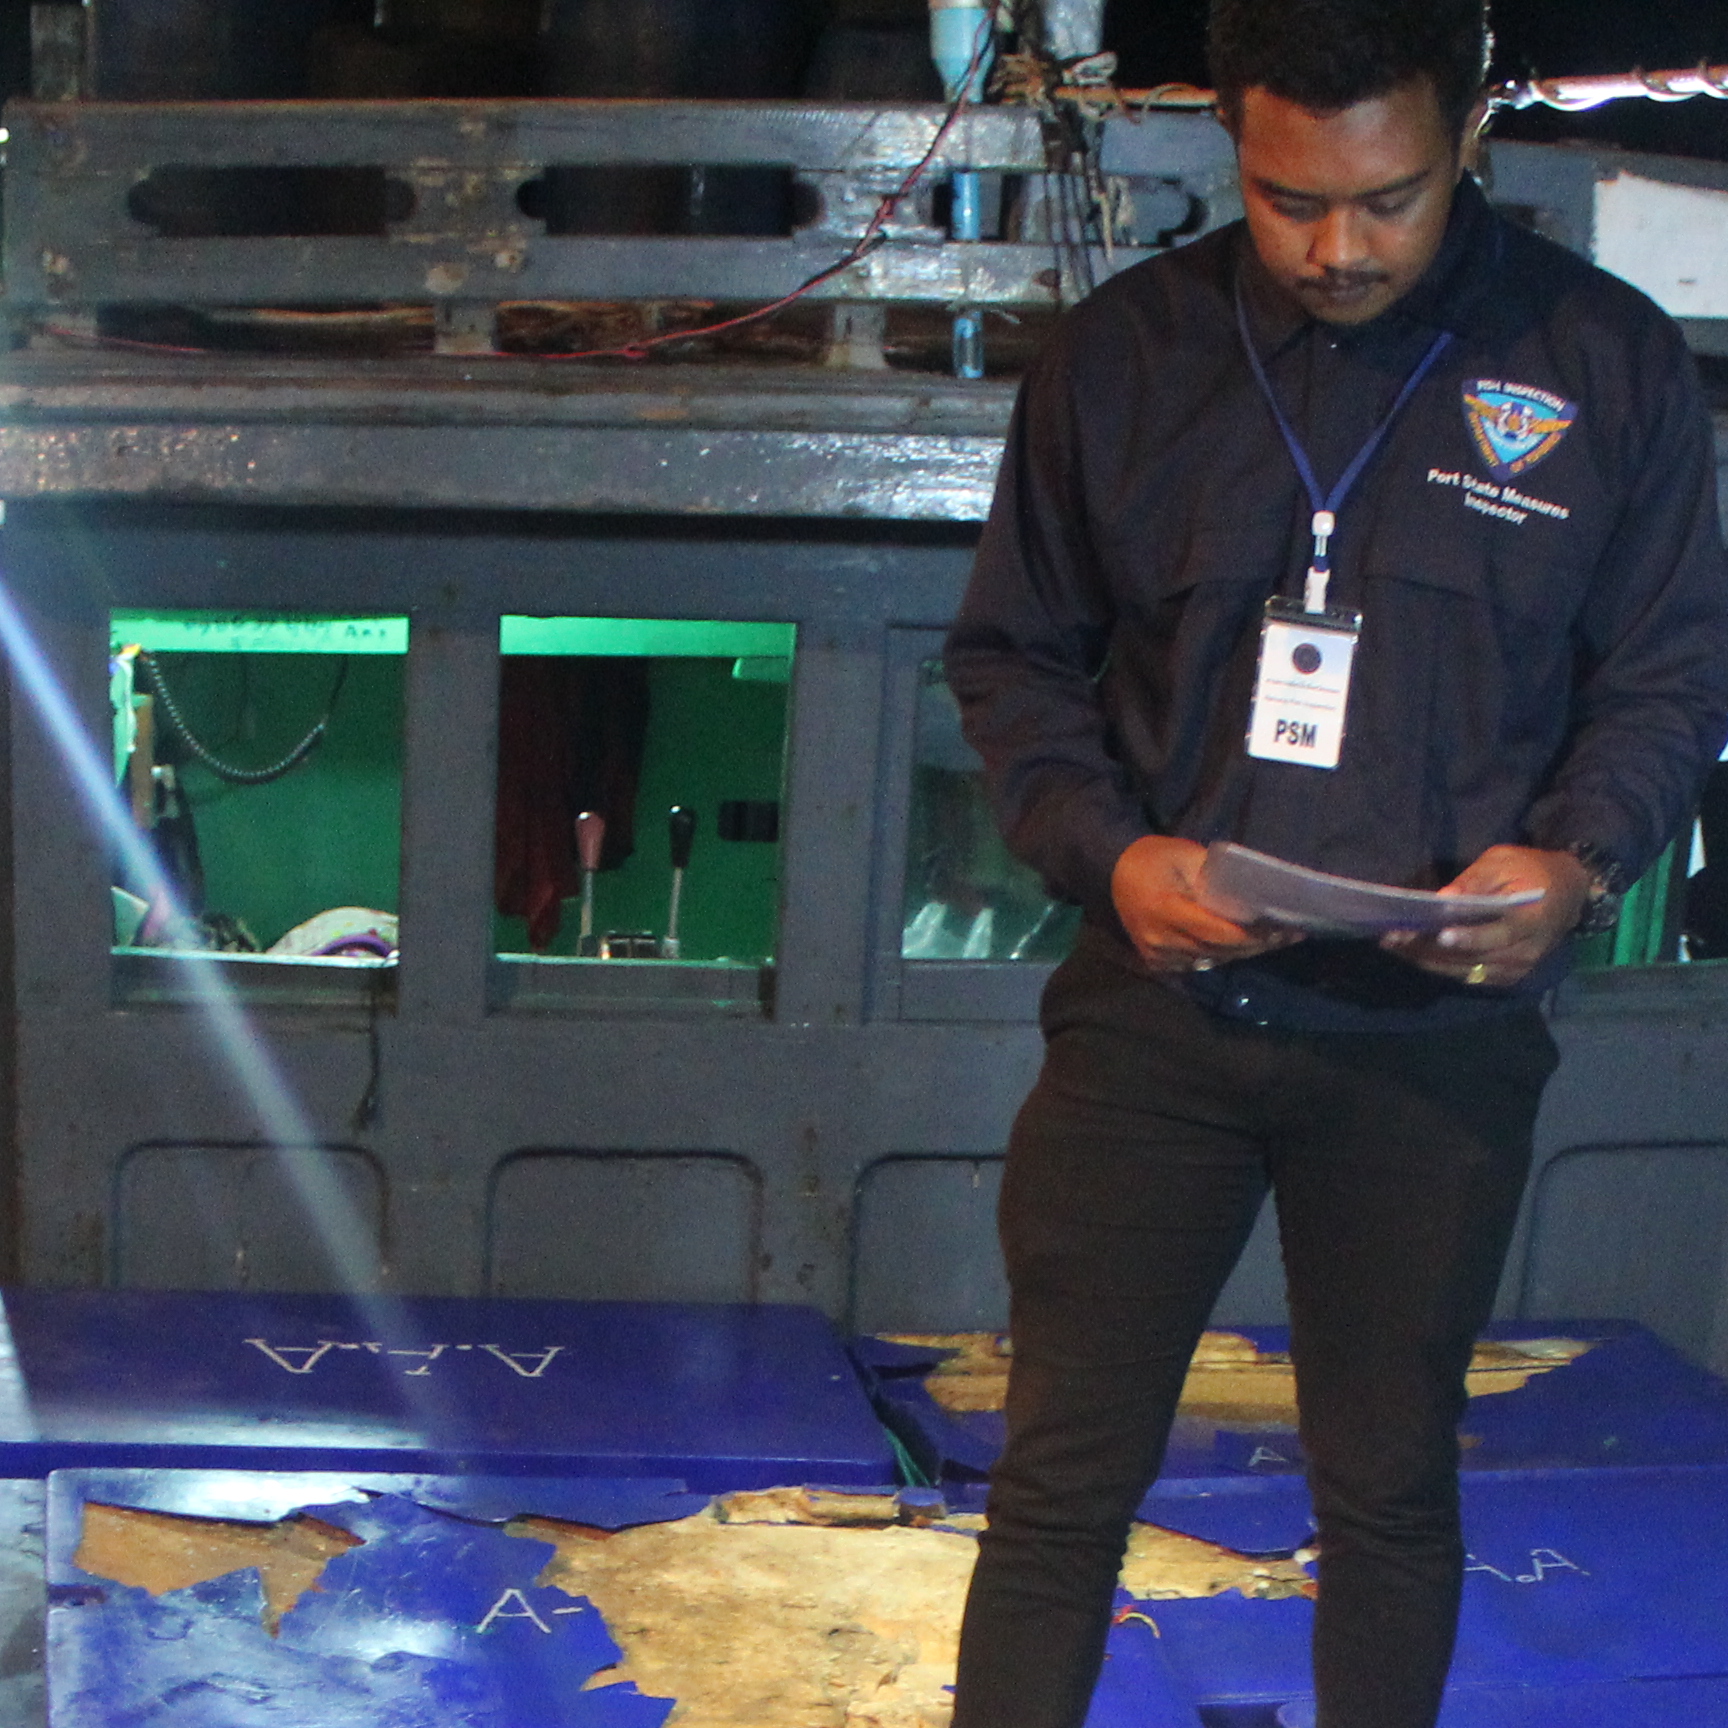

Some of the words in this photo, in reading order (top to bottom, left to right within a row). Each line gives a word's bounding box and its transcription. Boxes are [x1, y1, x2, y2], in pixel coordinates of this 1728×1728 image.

[1427, 468, 1460, 486] Port
[1462, 474, 1501, 498] State
[1501, 486, 1571, 520] Measures
[1464, 491, 1528, 525] Inspector
[1274, 718, 1318, 748] PSM
